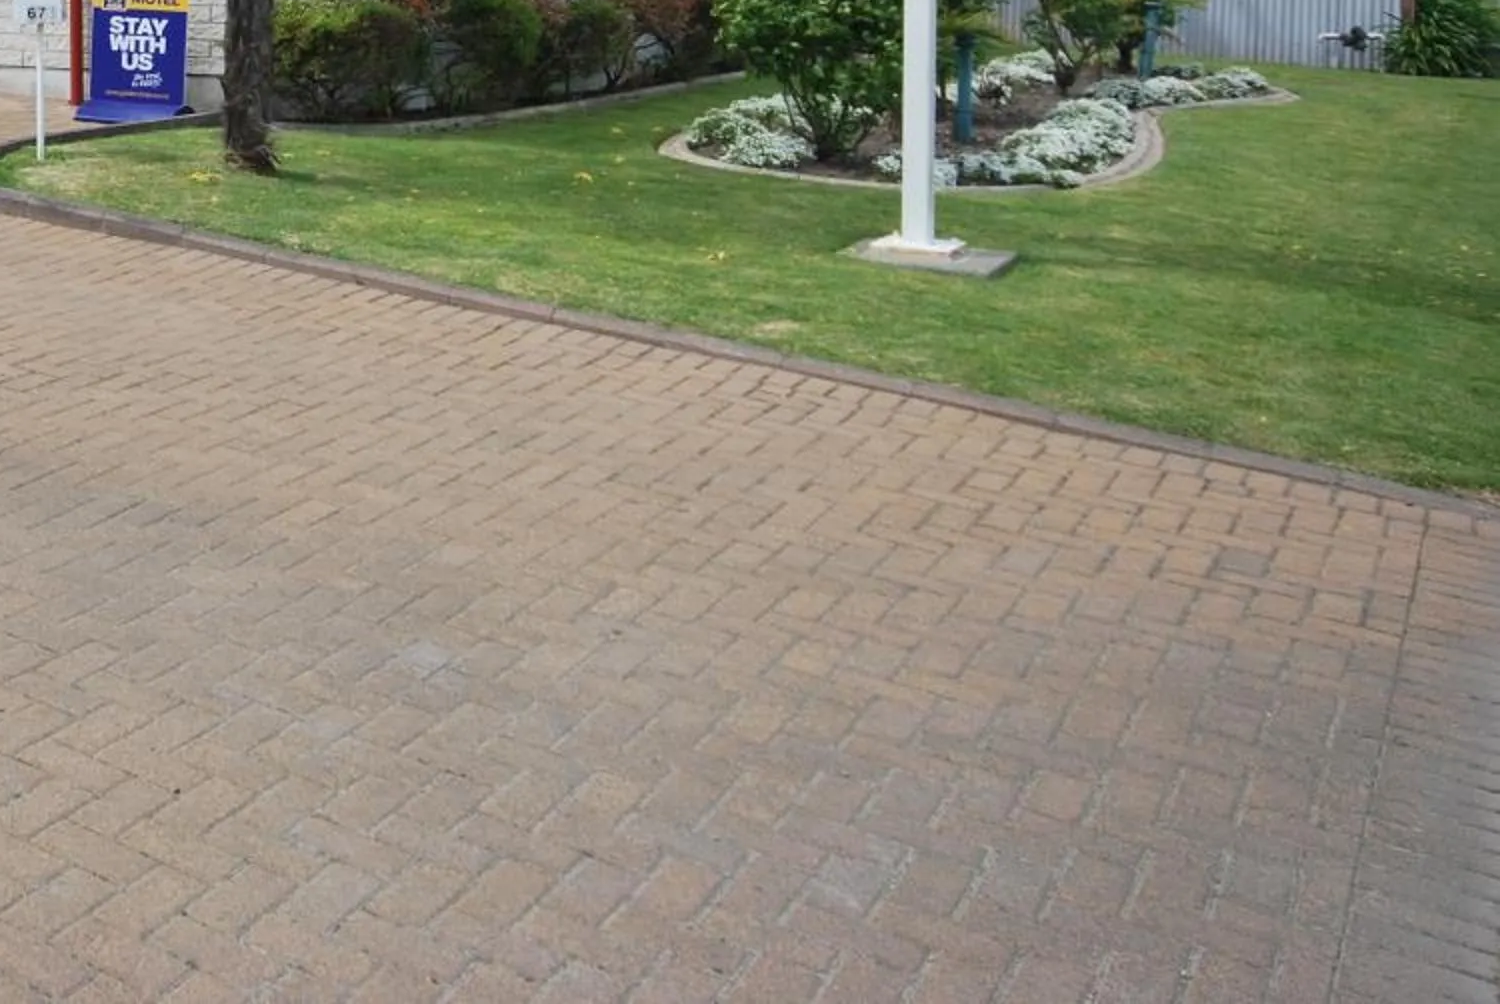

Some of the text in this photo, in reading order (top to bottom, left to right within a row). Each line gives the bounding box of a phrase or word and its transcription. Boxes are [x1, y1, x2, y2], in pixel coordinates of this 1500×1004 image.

[27, 7, 46, 21] 67
[109, 15, 169, 37] STAY
[109, 33, 167, 55] WITH
[121, 51, 153, 71] US
